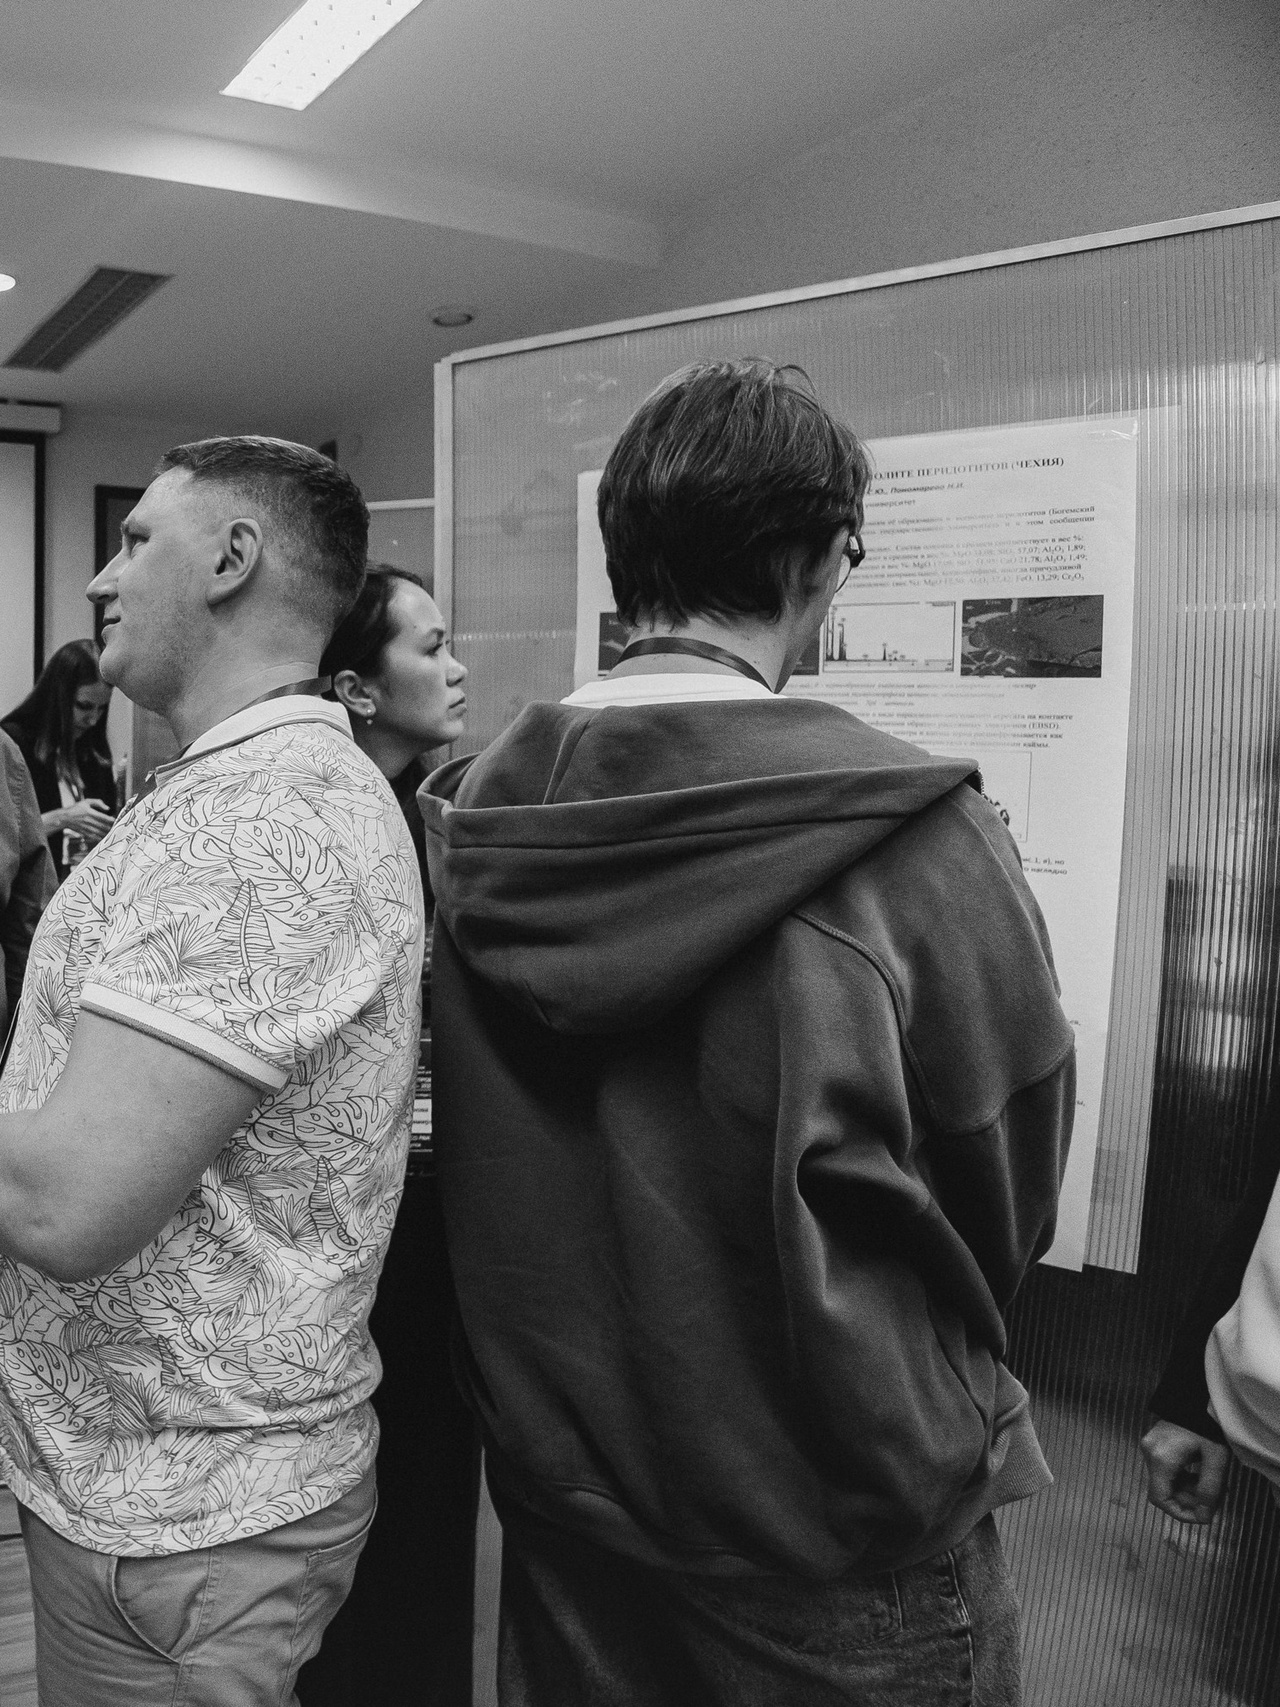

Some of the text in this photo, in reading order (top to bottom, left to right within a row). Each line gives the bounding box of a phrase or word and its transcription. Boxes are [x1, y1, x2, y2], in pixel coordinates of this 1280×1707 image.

[871, 457, 1064, 480] ОЛИТЕ ПЕРИДОТИТОВ (ЧЕХИЯ)
[1049, 515, 1095, 524] сообщении
